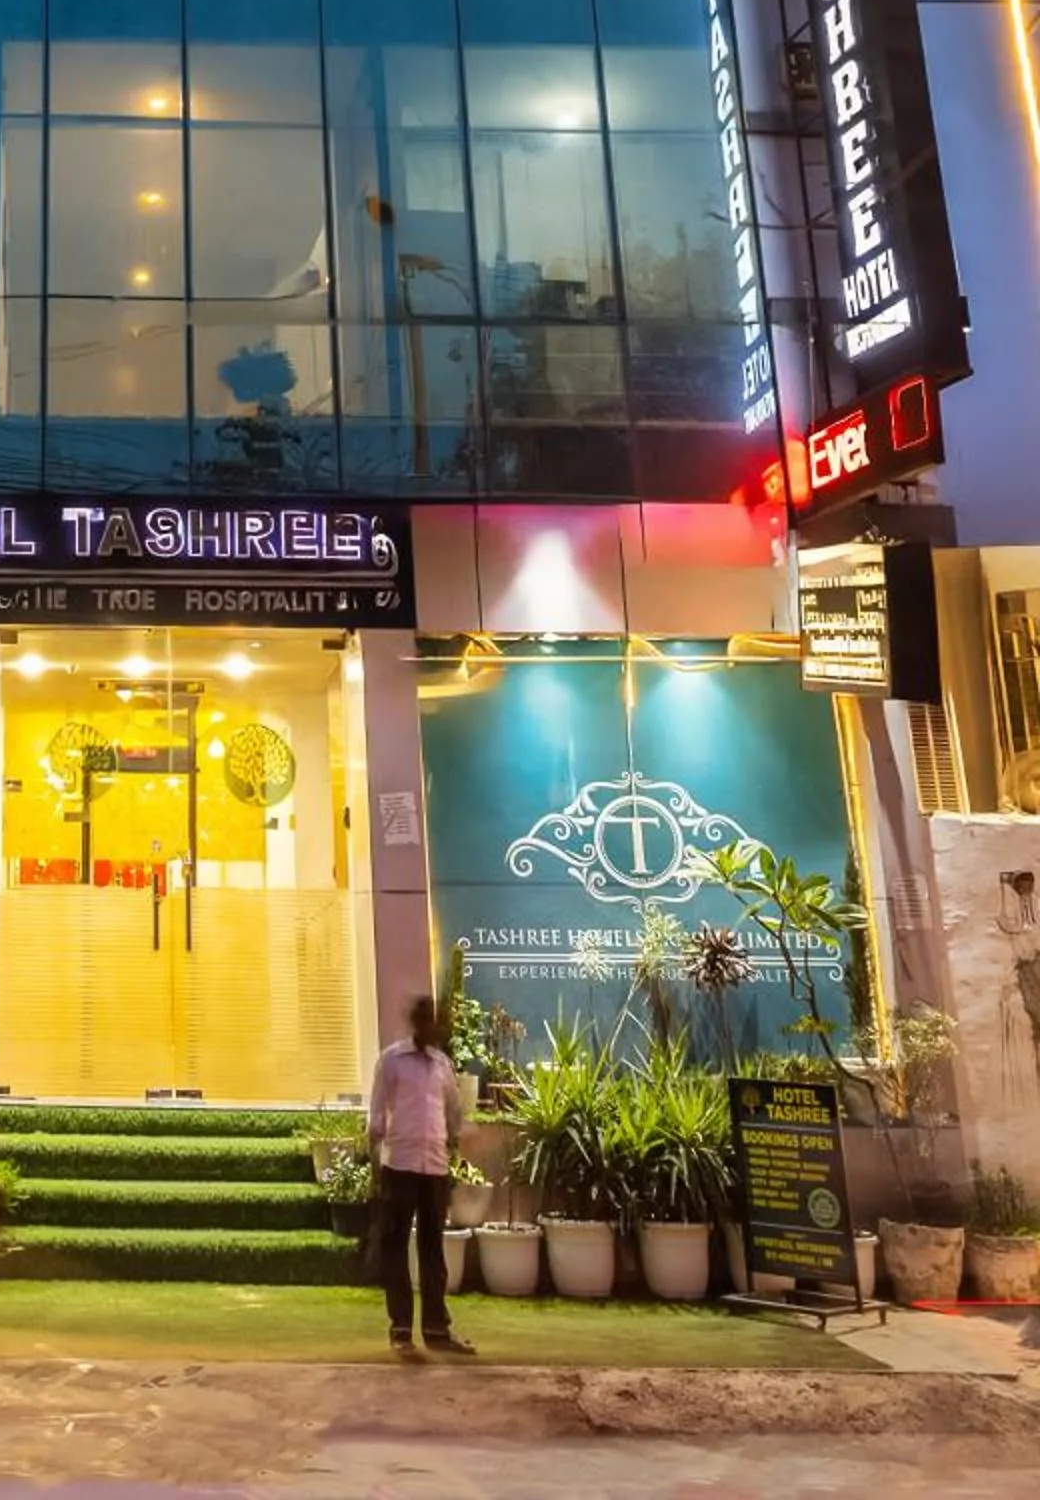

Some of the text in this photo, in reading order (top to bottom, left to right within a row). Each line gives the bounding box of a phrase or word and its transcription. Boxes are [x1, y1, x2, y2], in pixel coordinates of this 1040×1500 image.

[62, 507, 364, 561] TASHREE
[474, 928, 561, 947] TASHREE
[736, 931, 822, 949] LIMITED
[498, 965, 601, 980] EXPERIENC
[773, 1086, 820, 1104] HOTEL
[765, 1104, 831, 1125] TASHREE
[741, 1129, 833, 1151] BOOKINGS OPEN
